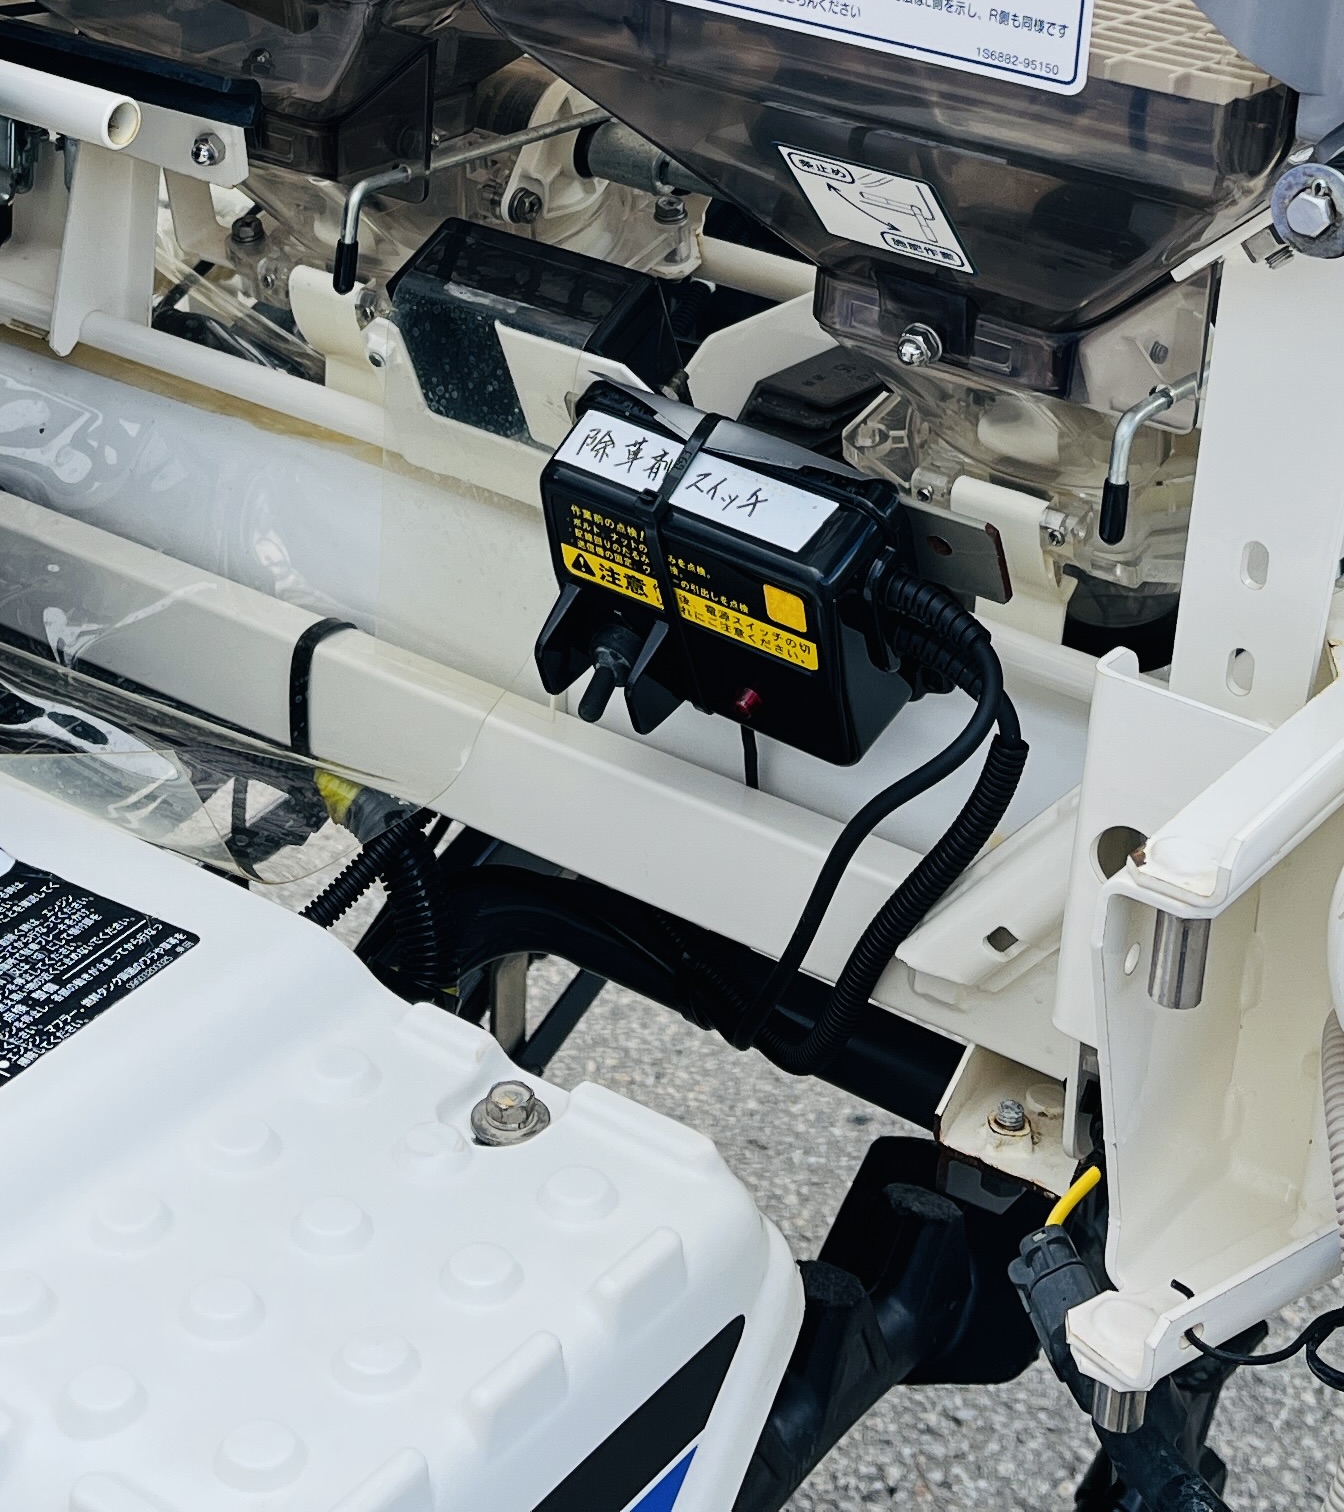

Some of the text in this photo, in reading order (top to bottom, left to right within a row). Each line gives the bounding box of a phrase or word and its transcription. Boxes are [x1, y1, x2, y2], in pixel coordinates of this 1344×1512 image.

[686, 472, 768, 517] スイッチ
[599, 563, 649, 598] 注意
